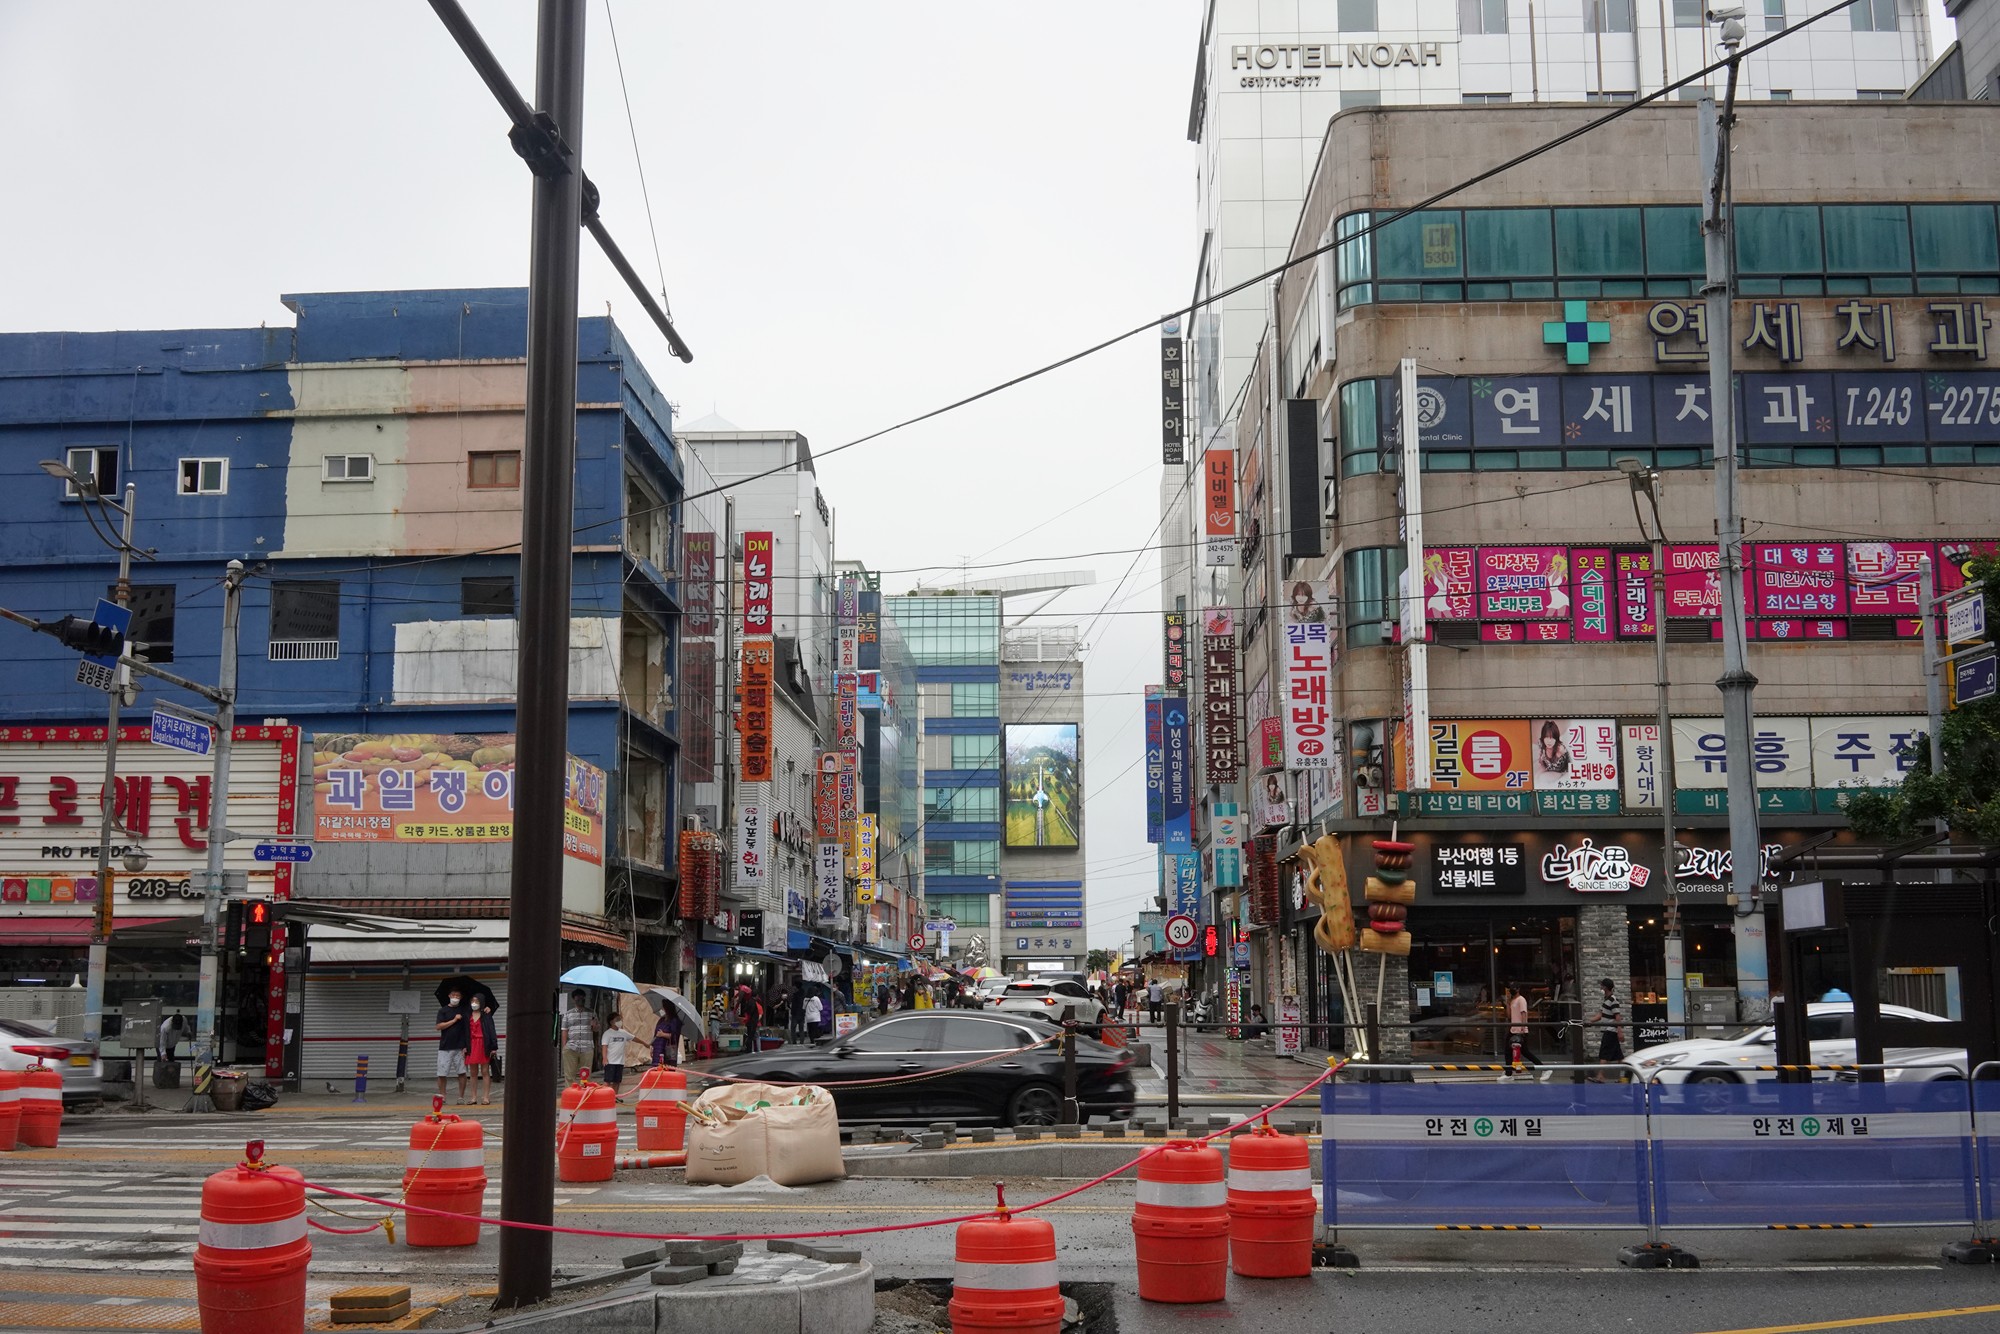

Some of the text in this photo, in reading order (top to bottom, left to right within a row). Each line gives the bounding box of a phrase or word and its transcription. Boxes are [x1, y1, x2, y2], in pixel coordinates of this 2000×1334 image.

[1232, 42, 1441, 69] HOTEL NOAH
[1648, 301, 1992, 363] 연세치과
[1163, 347, 1181, 437] 호텔노아
[1442, 433, 1463, 441] Clinic
[748, 540, 769, 551] DM
[1216, 555, 1225, 563] 5F
[1486, 554, 1540, 573] 애창곡
[1578, 556, 1606, 569] 오픈
[1764, 547, 1835, 565] 대형홀
[1447, 551, 1472, 609] 불꽃
[746, 554, 769, 626] 노래방
[1626, 572, 1648, 622] 노래방
[1487, 596, 1544, 614] 노래무료
[1580, 568, 1607, 634] 스테이지
[1765, 594, 1837, 611] 최신음향
[1455, 609, 1470, 618] 3F
[1287, 624, 1328, 644] 길목
[1623, 623, 1655, 633] 유흥 3F
[1206, 637, 1231, 652] 남포
[1169, 641, 1184, 684] 노래방
[1289, 646, 1330, 737] 노래방
[841, 687, 855, 728] 노래방
[1209, 655, 1234, 770] 노래연습장
[1629, 726, 1659, 741] 미인
[1302, 742, 1319, 753] 2F
[1569, 725, 1614, 761] 길목
[1296, 757, 1328, 767] 유흥주점
[1432, 725, 1461, 788] 길목
[1470, 736, 1503, 774] 룸
[1506, 771, 1529, 788] 2F
[1570, 763, 1604, 782] 노래방
[1636, 745, 1657, 807] 항시대기
[1543, 794, 1612, 811] 최신음향
[319, 815, 392, 830] 자갈치시장점
[404, 826, 425, 837] 각종
[489, 825, 511, 837] 환영
[41, 846, 73, 859] PRO
[269, 845, 297, 855] 구덕로
[1437, 847, 1519, 866] 부산여행 1등
[1438, 870, 1496, 888] 선물세트
[1577, 881, 1629, 890] SINCE 1963
[1676, 882, 1725, 895] Goraesa
[1174, 925, 1189, 939] 30
[1034, 938, 1072, 949] 주차장
[1425, 1117, 1542, 1137] 안전 제일
[1752, 1116, 1868, 1137] 안전 제일
